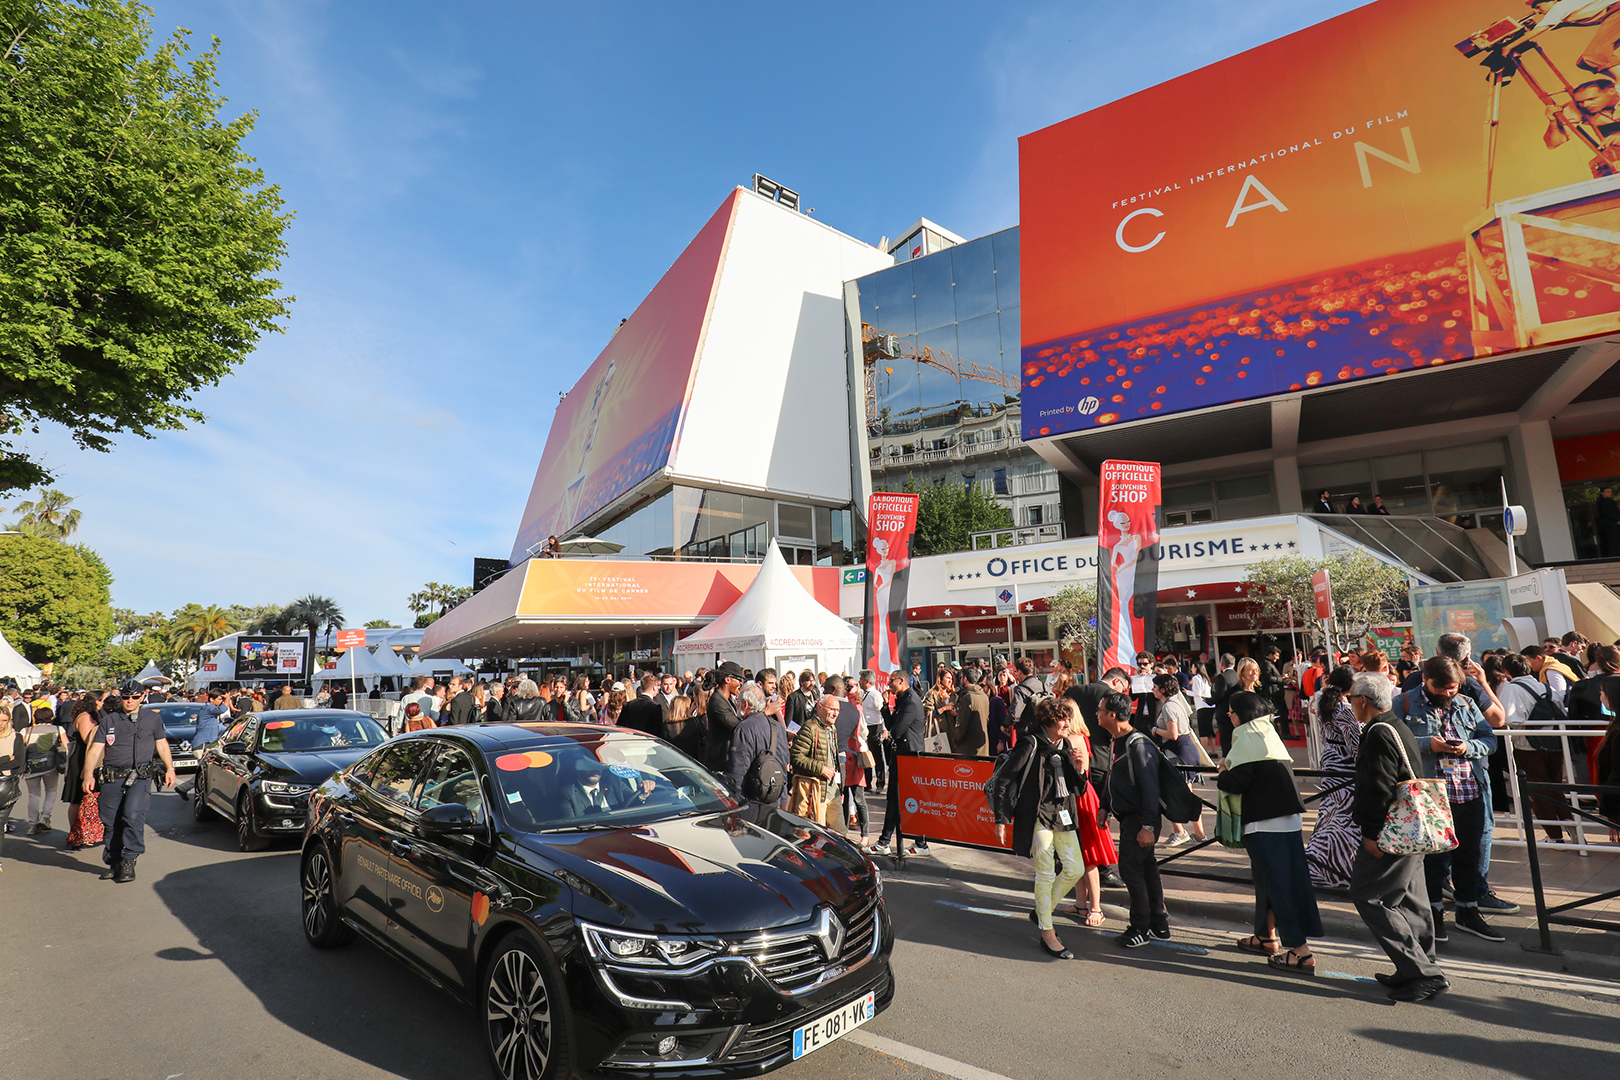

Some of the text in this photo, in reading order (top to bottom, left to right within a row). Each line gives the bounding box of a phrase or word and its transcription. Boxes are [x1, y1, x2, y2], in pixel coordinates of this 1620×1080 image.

[1112, 109, 1408, 208] FESTIVAL INTERNATIONAL DU FILM
[1040, 407, 1064, 417] Printed
[1078, 396, 1099, 415] hp
[1117, 464, 1154, 472] BOUTIQUE
[1105, 472, 1154, 481] OFFICIELLE
[1111, 491, 1147, 503] SHOP
[873, 503, 912, 512] OFFICIELLE
[876, 520, 905, 532] SHOP
[987, 556, 1068, 576] OFFICE
[857, 572, 865, 581] P
[1229, 612, 1250, 620] ENTRÉE
[770, 637, 823, 646] ACCRÉDITATIONS
[912, 776, 947, 787] VILLAGE
[919, 800, 957, 810] Pantiero-side
[358, 854, 422, 900] RENAULT PARTENAIRE OFFICIEL
[804, 1000, 865, 1050] FE-081-VK
